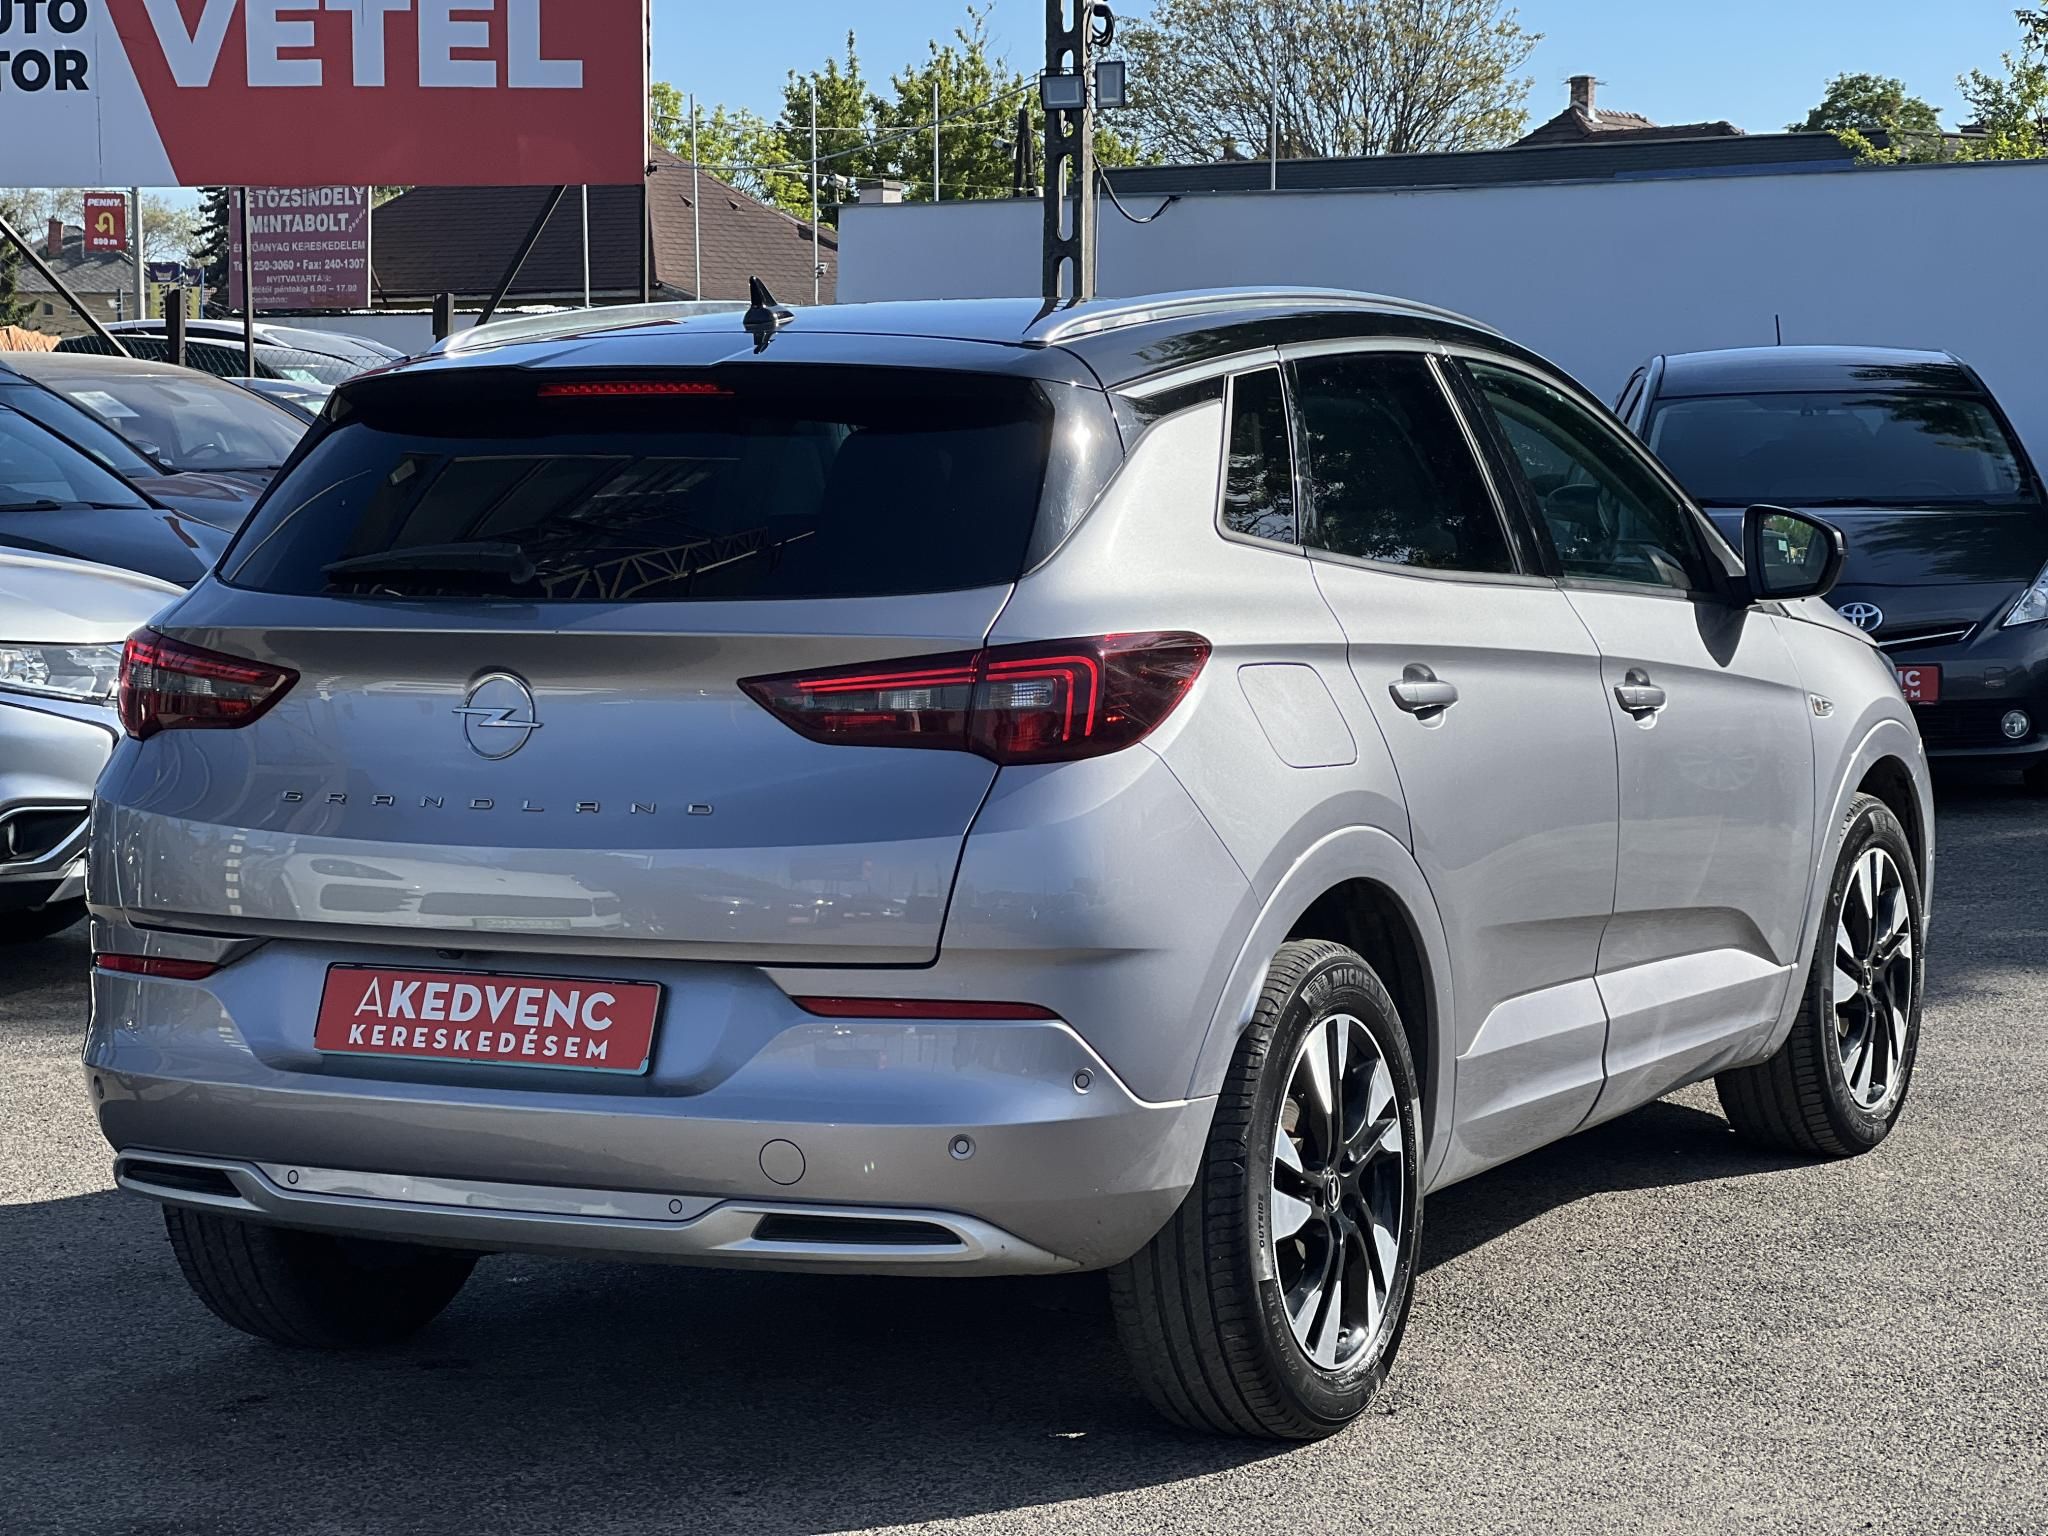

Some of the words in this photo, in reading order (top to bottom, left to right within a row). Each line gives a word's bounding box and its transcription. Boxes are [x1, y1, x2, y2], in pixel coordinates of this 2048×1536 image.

[142, 0, 585, 88] VETEL
[250, 213, 349, 234] MINTABOLT
[291, 240, 365, 251] KERESKEDELEM
[253, 260, 294, 271] 250-3060
[303, 259, 322, 270] Fax:
[324, 258, 365, 269] 240-1307
[281, 789, 715, 816] GRANDLAND
[347, 1023, 608, 1060] KERESKEDÉSEM
